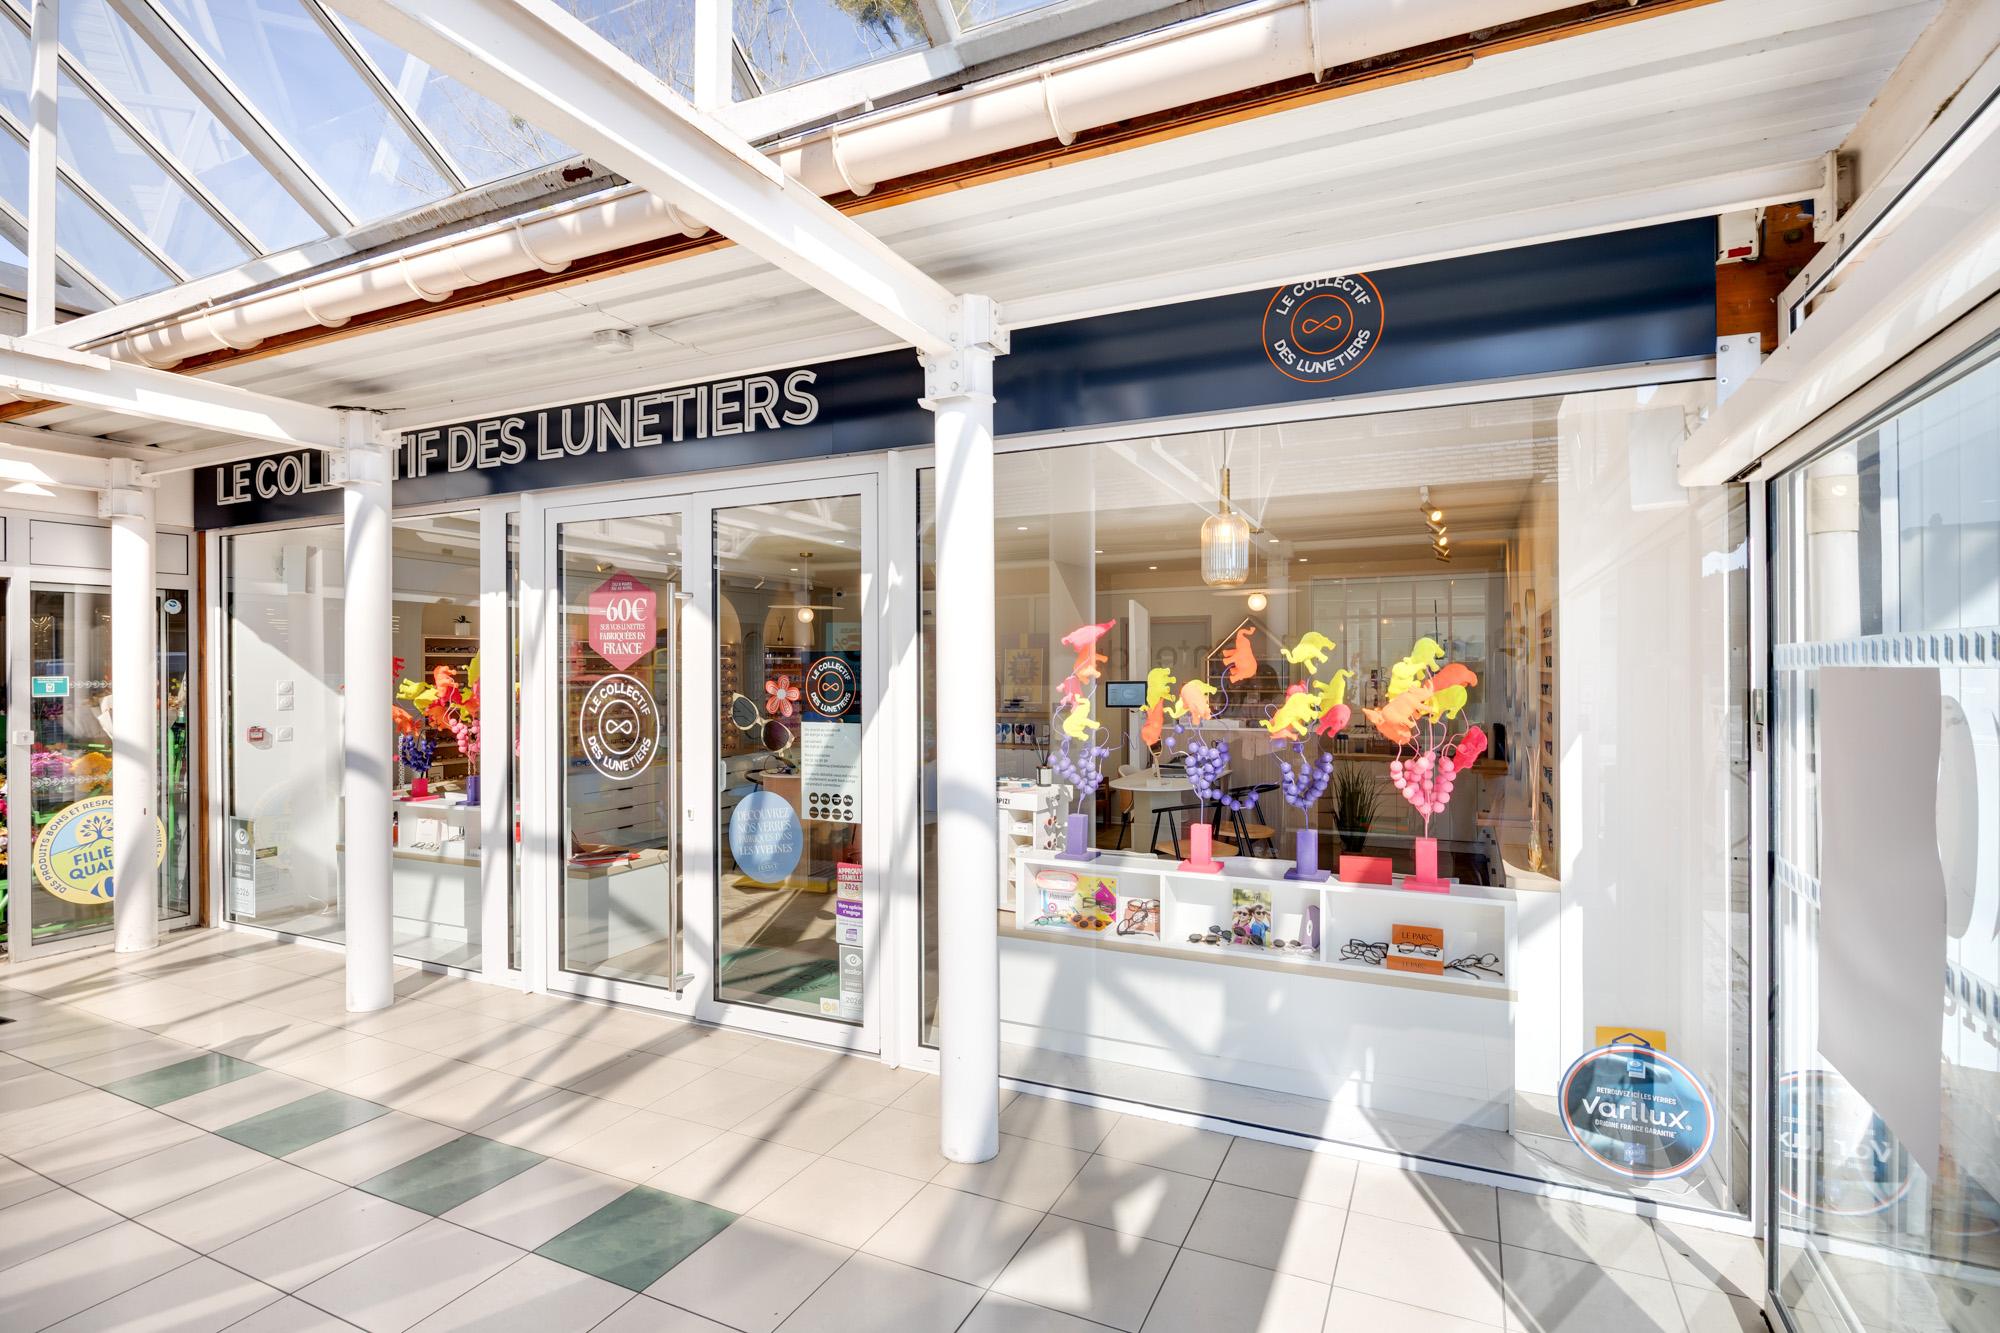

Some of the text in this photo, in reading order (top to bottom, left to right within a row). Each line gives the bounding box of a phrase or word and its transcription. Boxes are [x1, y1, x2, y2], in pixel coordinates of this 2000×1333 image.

[1276, 276, 1371, 316] LE COLLECTIF
[1274, 328, 1371, 374] DES LUNETIERS
[216, 462, 251, 506] LE
[447, 416, 527, 473] DES
[537, 370, 819, 461] LUNETIERS
[599, 631, 645, 641] FABRIQUÉES EN
[620, 623, 645, 631] LUNETTES
[603, 642, 642, 655] FRANCE
[811, 661, 851, 681] LE COLLECTIF
[588, 682, 651, 716] LE COLLECTIF
[810, 691, 852, 712] DES LUNETIERS
[587, 735, 651, 771] DES LUNETIERS
[757, 819, 792, 833] VERRES
[38, 805, 81, 894] DES PRODUITS BONS ET
[838, 867, 863, 876] APPROUV
[844, 882, 859, 891] 2026
[1412, 932, 1433, 942] PARC
[1596, 1086, 1630, 1098] RETROUVEZ
[1640, 1093, 1652, 1101] LES
[1652, 1095, 1678, 1106] VERRES
[1620, 1123, 1645, 1133] FRANCE
